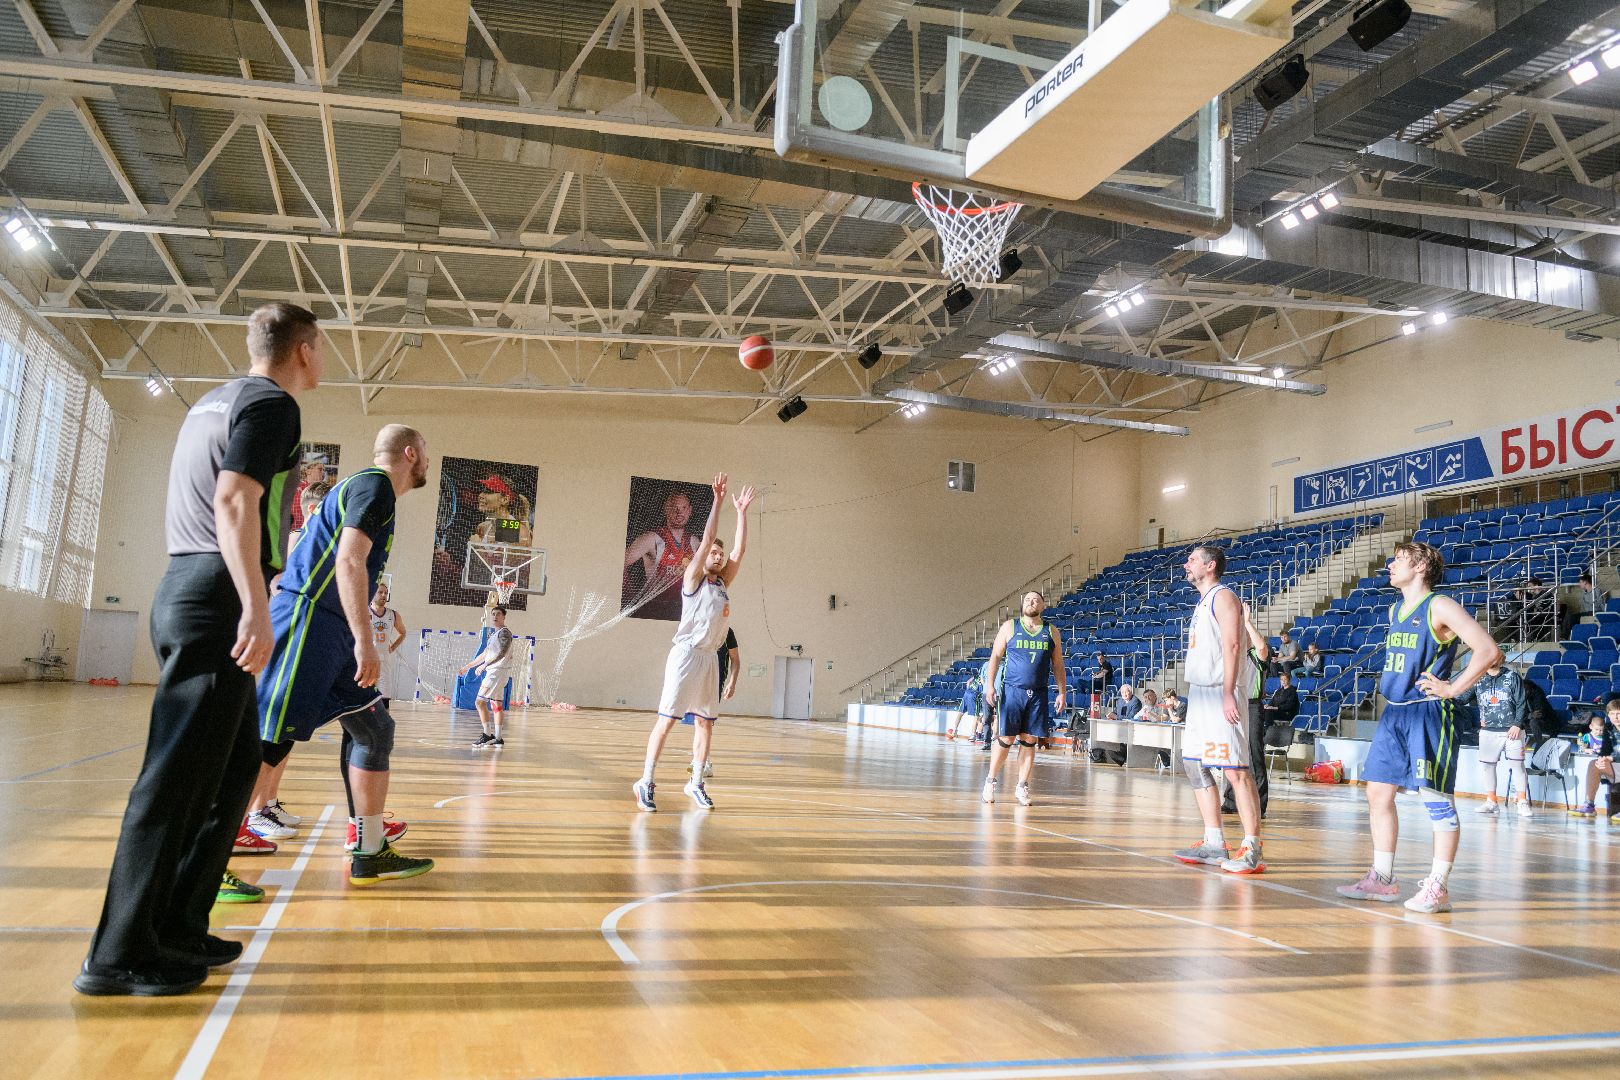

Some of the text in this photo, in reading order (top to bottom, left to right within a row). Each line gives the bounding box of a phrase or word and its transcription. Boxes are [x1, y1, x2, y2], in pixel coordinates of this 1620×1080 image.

[1501, 405, 1620, 475] БЫС
[1029, 652, 1036, 663] 7
[1384, 652, 1405, 673] 30
[1204, 741, 1230, 760] 23
